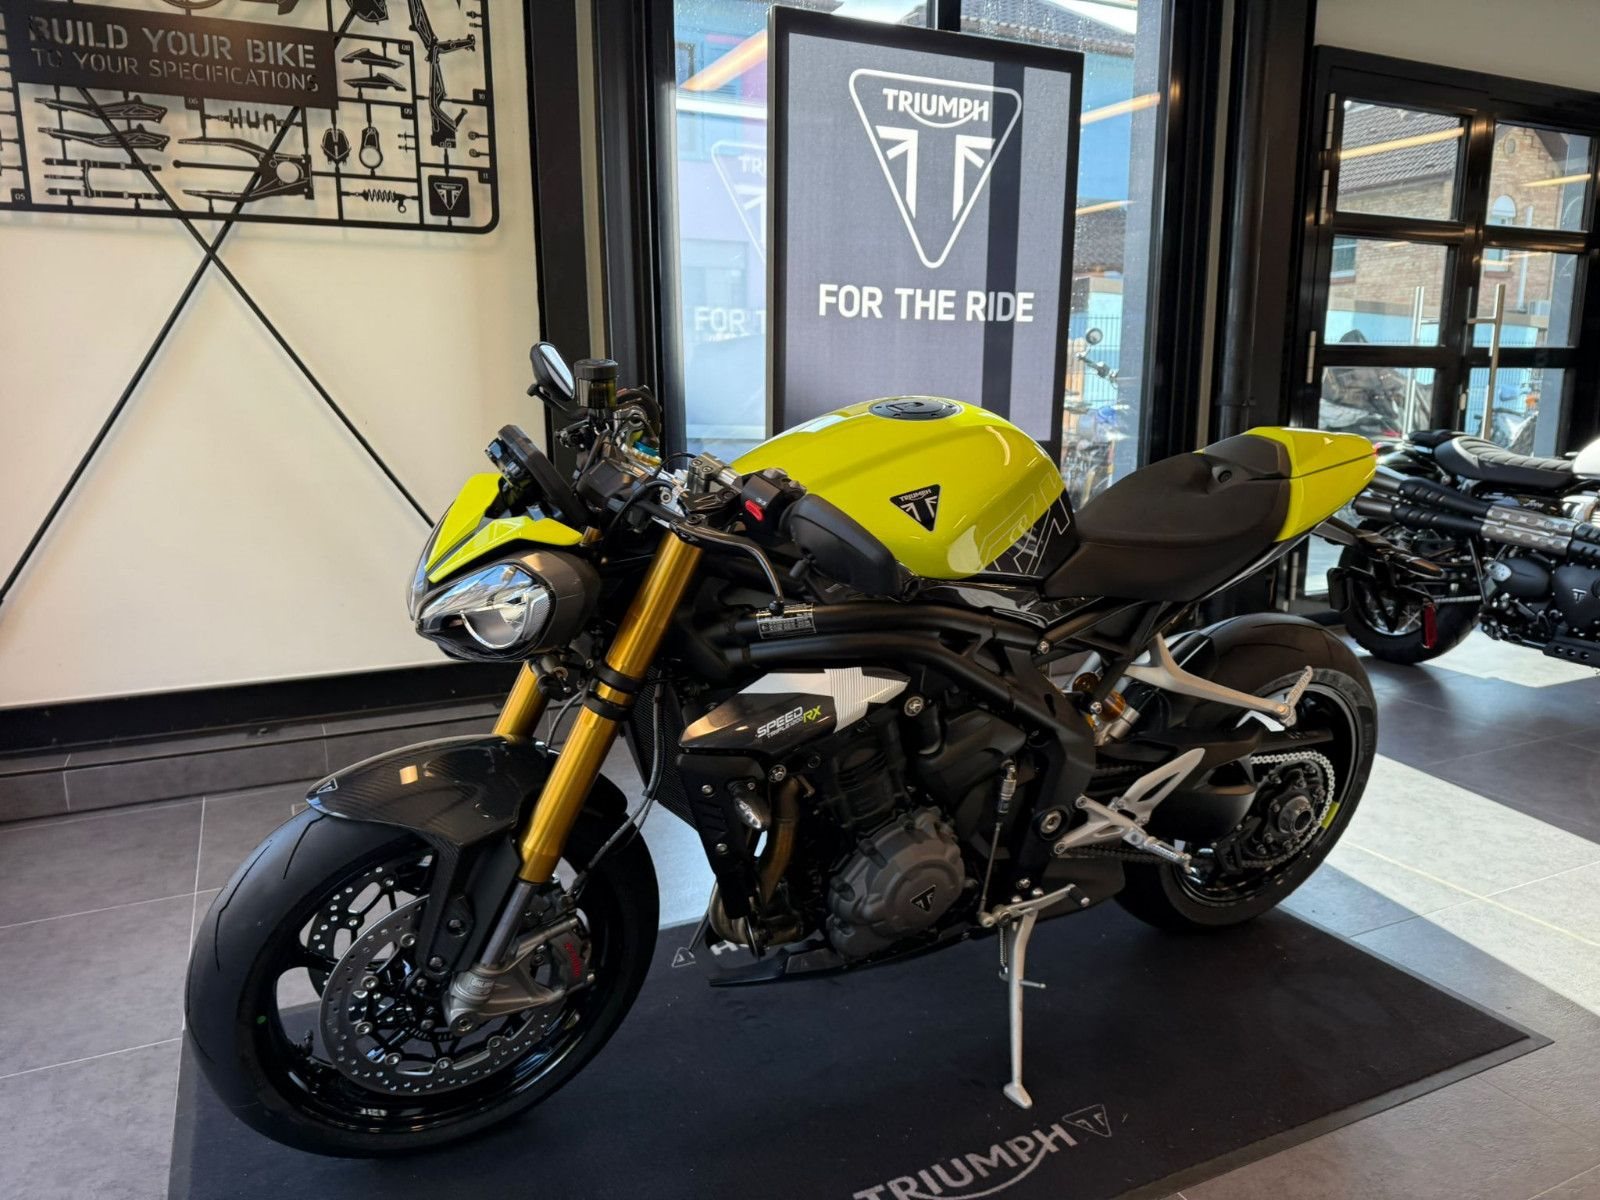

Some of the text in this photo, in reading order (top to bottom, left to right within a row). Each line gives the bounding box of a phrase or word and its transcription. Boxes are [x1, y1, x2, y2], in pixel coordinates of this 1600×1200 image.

[29, 15, 316, 69] BUILD YOUR BIKE
[30, 48, 319, 92] TO YOUR SPECIFICATIONS
[882, 88, 990, 125] TRIUMPH
[818, 284, 1035, 323] FOR THE RIDE
[756, 705, 821, 738] SPEED RX
[853, 1122, 1078, 1200] TRIUMPH
